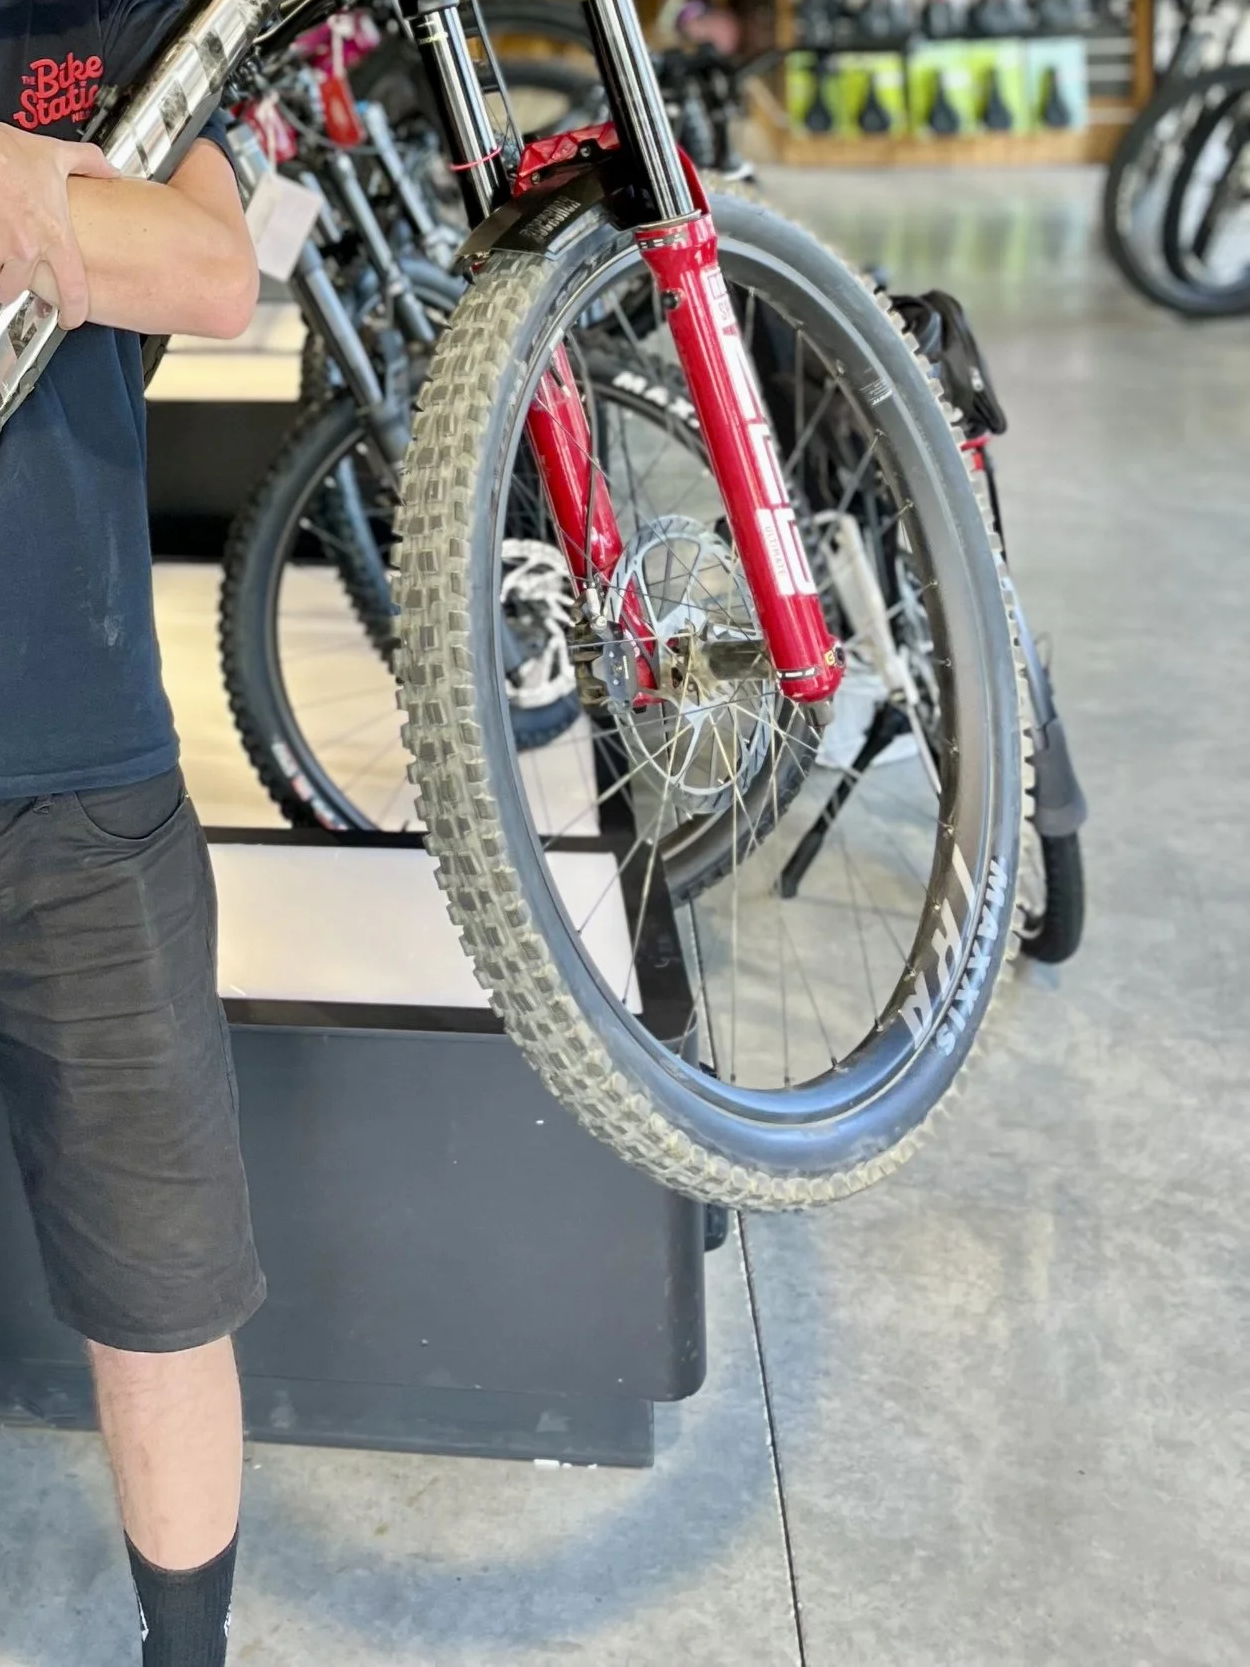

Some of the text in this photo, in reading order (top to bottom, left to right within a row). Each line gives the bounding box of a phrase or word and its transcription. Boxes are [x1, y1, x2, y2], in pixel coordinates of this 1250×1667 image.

[21, 75, 37, 85] THE
[29, 52, 104, 99] Bike
[764, 525, 786, 577] ULTIMATE
[935, 856, 1008, 1057] MAXXIS
